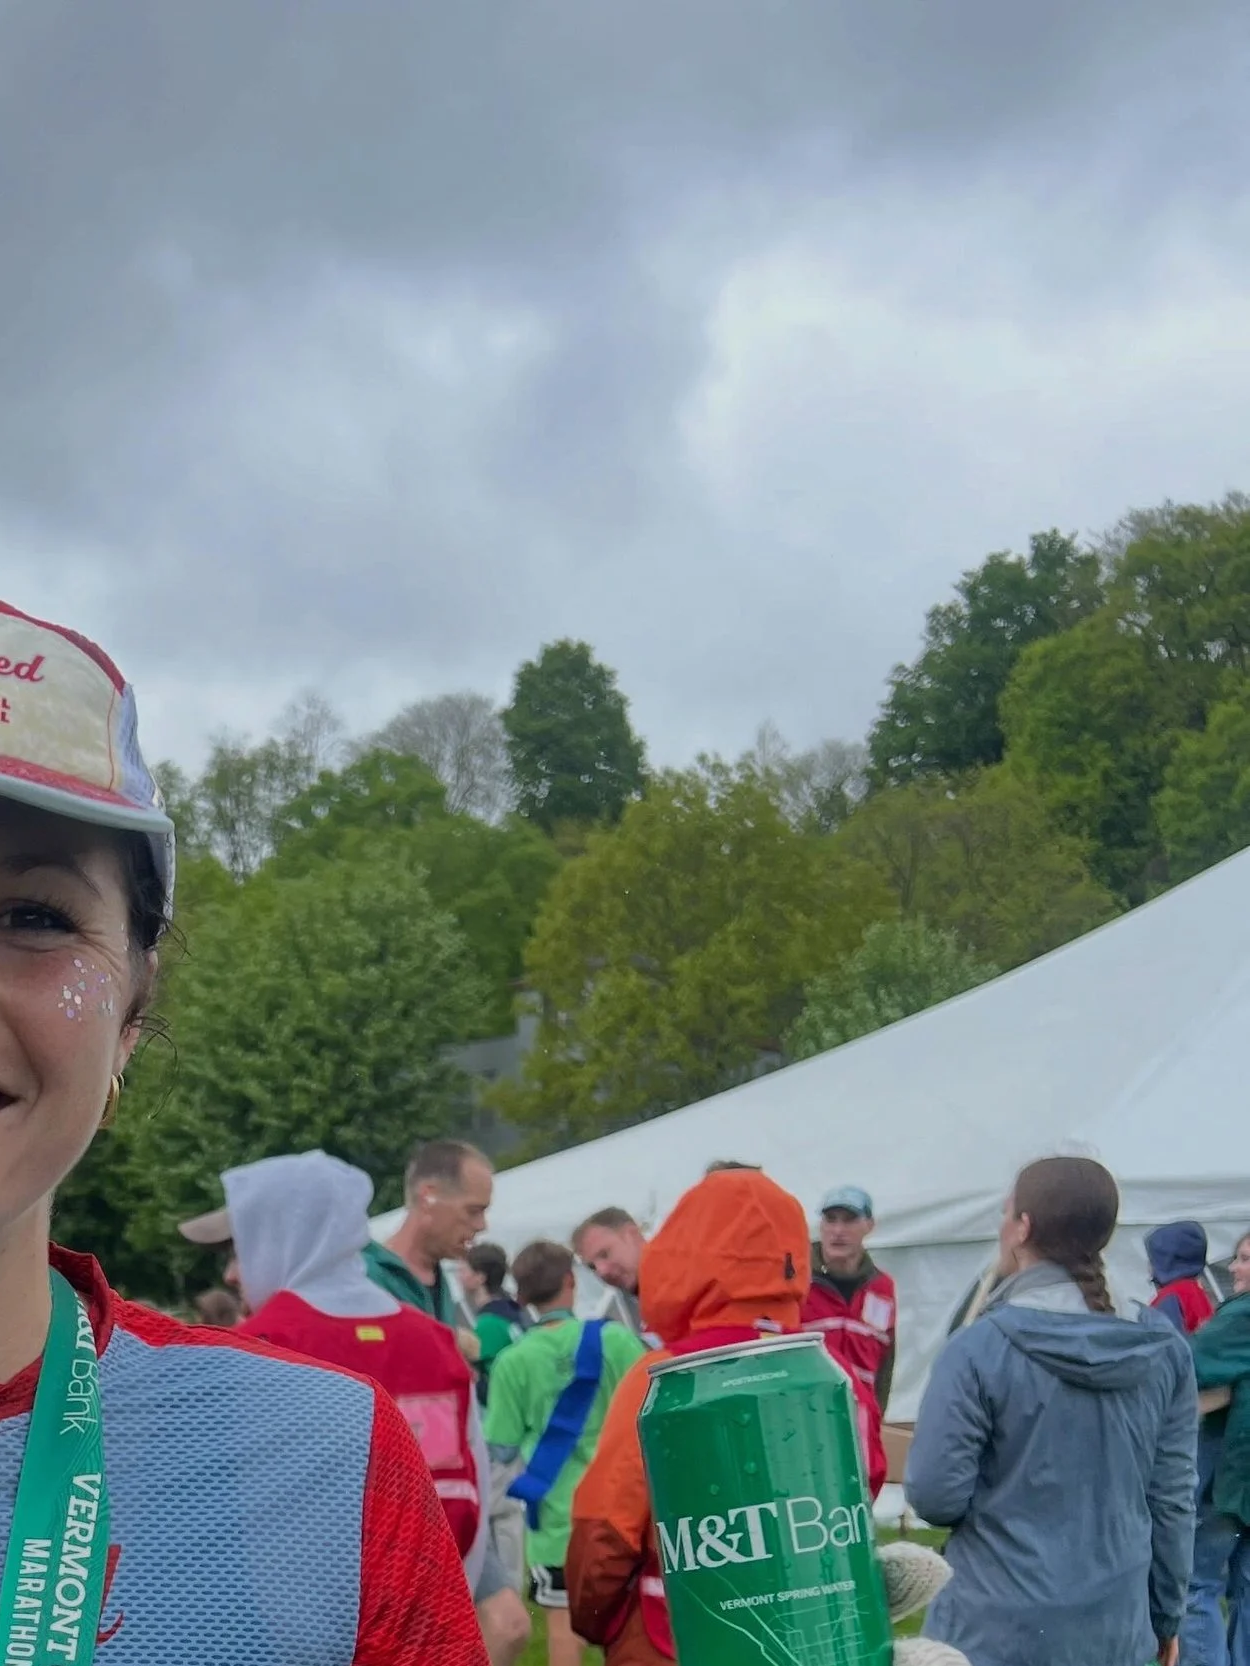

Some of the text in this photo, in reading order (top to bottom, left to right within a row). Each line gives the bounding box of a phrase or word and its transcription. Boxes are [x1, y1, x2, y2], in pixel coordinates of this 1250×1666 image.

[59, 1359, 99, 1435] Bank
[47, 1471, 102, 1662] VERMONT
[656, 1496, 869, 1574] M&T Ban
[719, 1580, 856, 1611] VERMONT SPRING WATER
